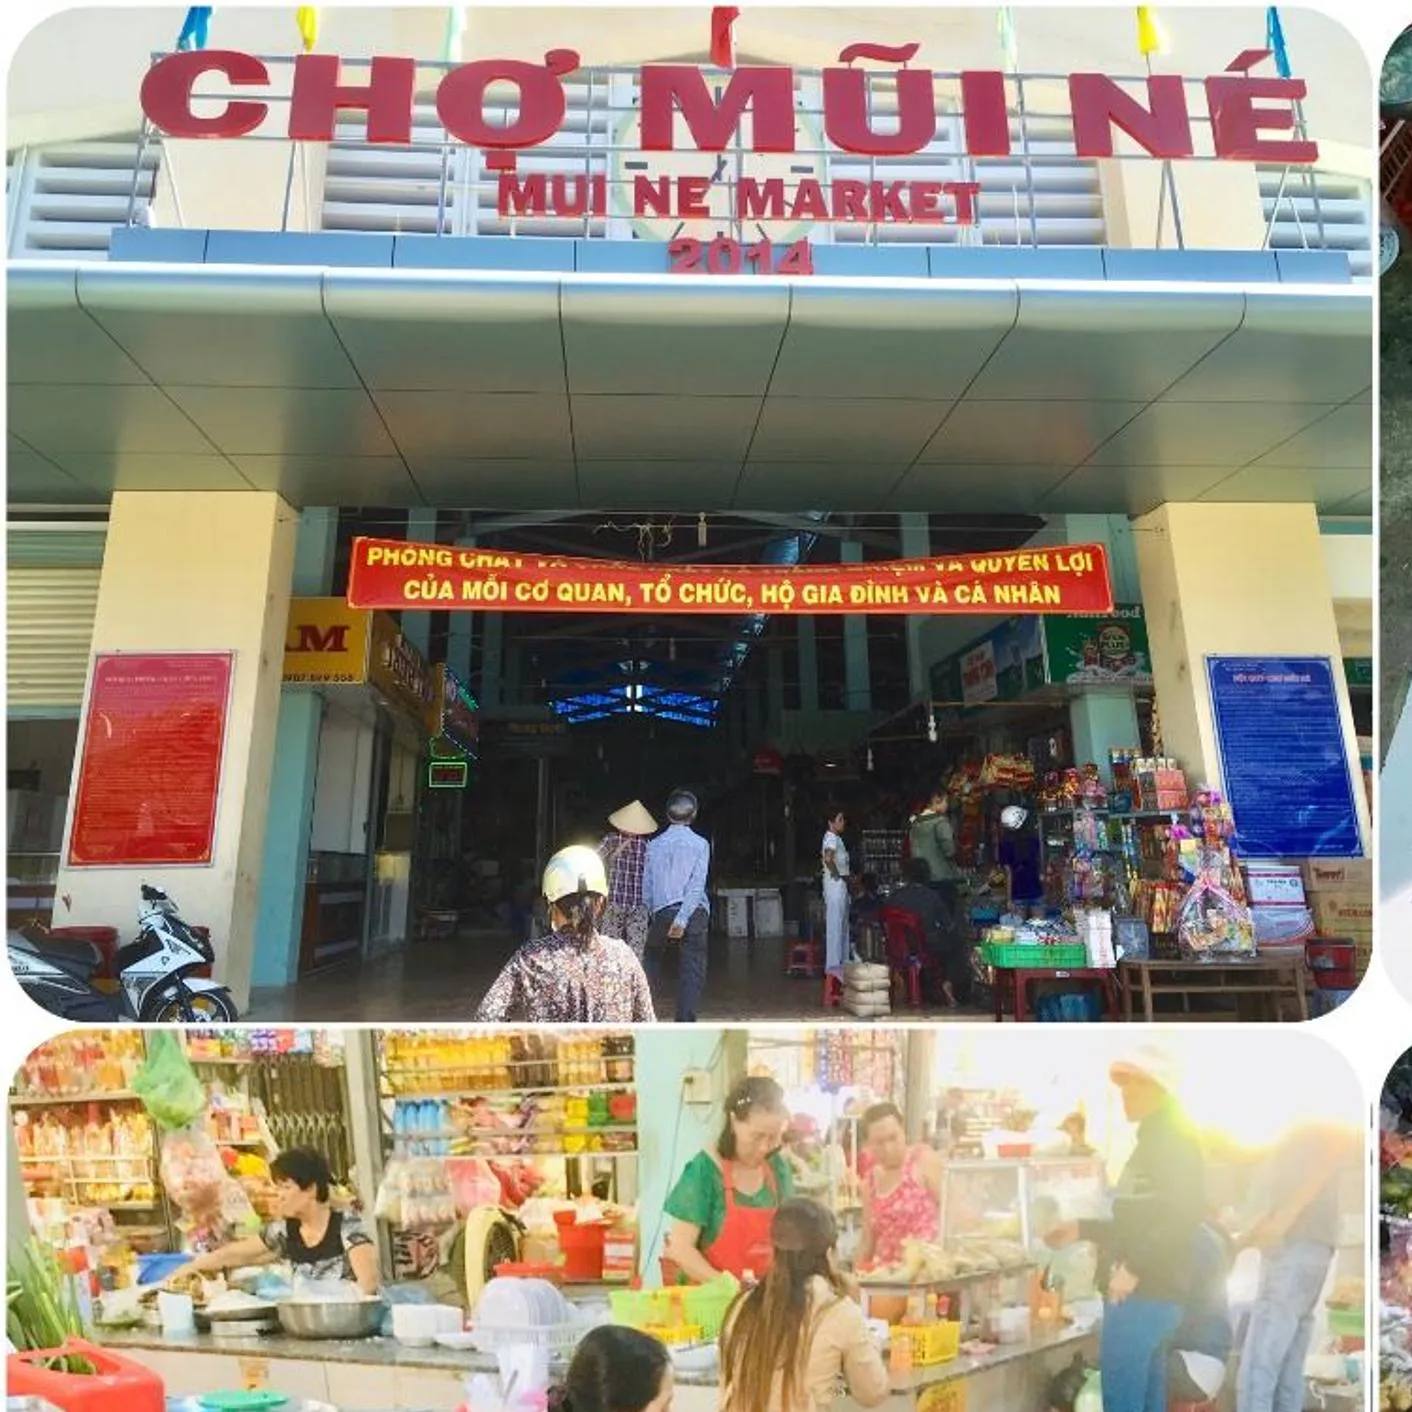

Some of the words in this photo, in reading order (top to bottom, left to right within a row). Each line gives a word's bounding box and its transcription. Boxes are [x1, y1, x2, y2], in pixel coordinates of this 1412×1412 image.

[140, 48, 580, 170] CHỢ
[641, 43, 1011, 157] MŨI
[1067, 49, 1319, 163] NÉ
[498, 172, 606, 219] MUI
[633, 175, 710, 220] NE
[736, 176, 980, 226] MARKET
[666, 236, 814, 276] 2014
[402, 574, 455, 601] CỦA
[514, 580, 550, 602] CƠ
[556, 582, 633, 607] QUAN,
[639, 573, 673, 603] TỔ
[678, 577, 754, 608] CHỨC,
[761, 579, 796, 614] HỘ
[802, 582, 843, 605] GIA
[850, 578, 909, 605] ĐÌNH
[916, 578, 949, 605] VÀ
[953, 578, 987, 605] CÁ
[992, 578, 1061, 605] NHÂN
